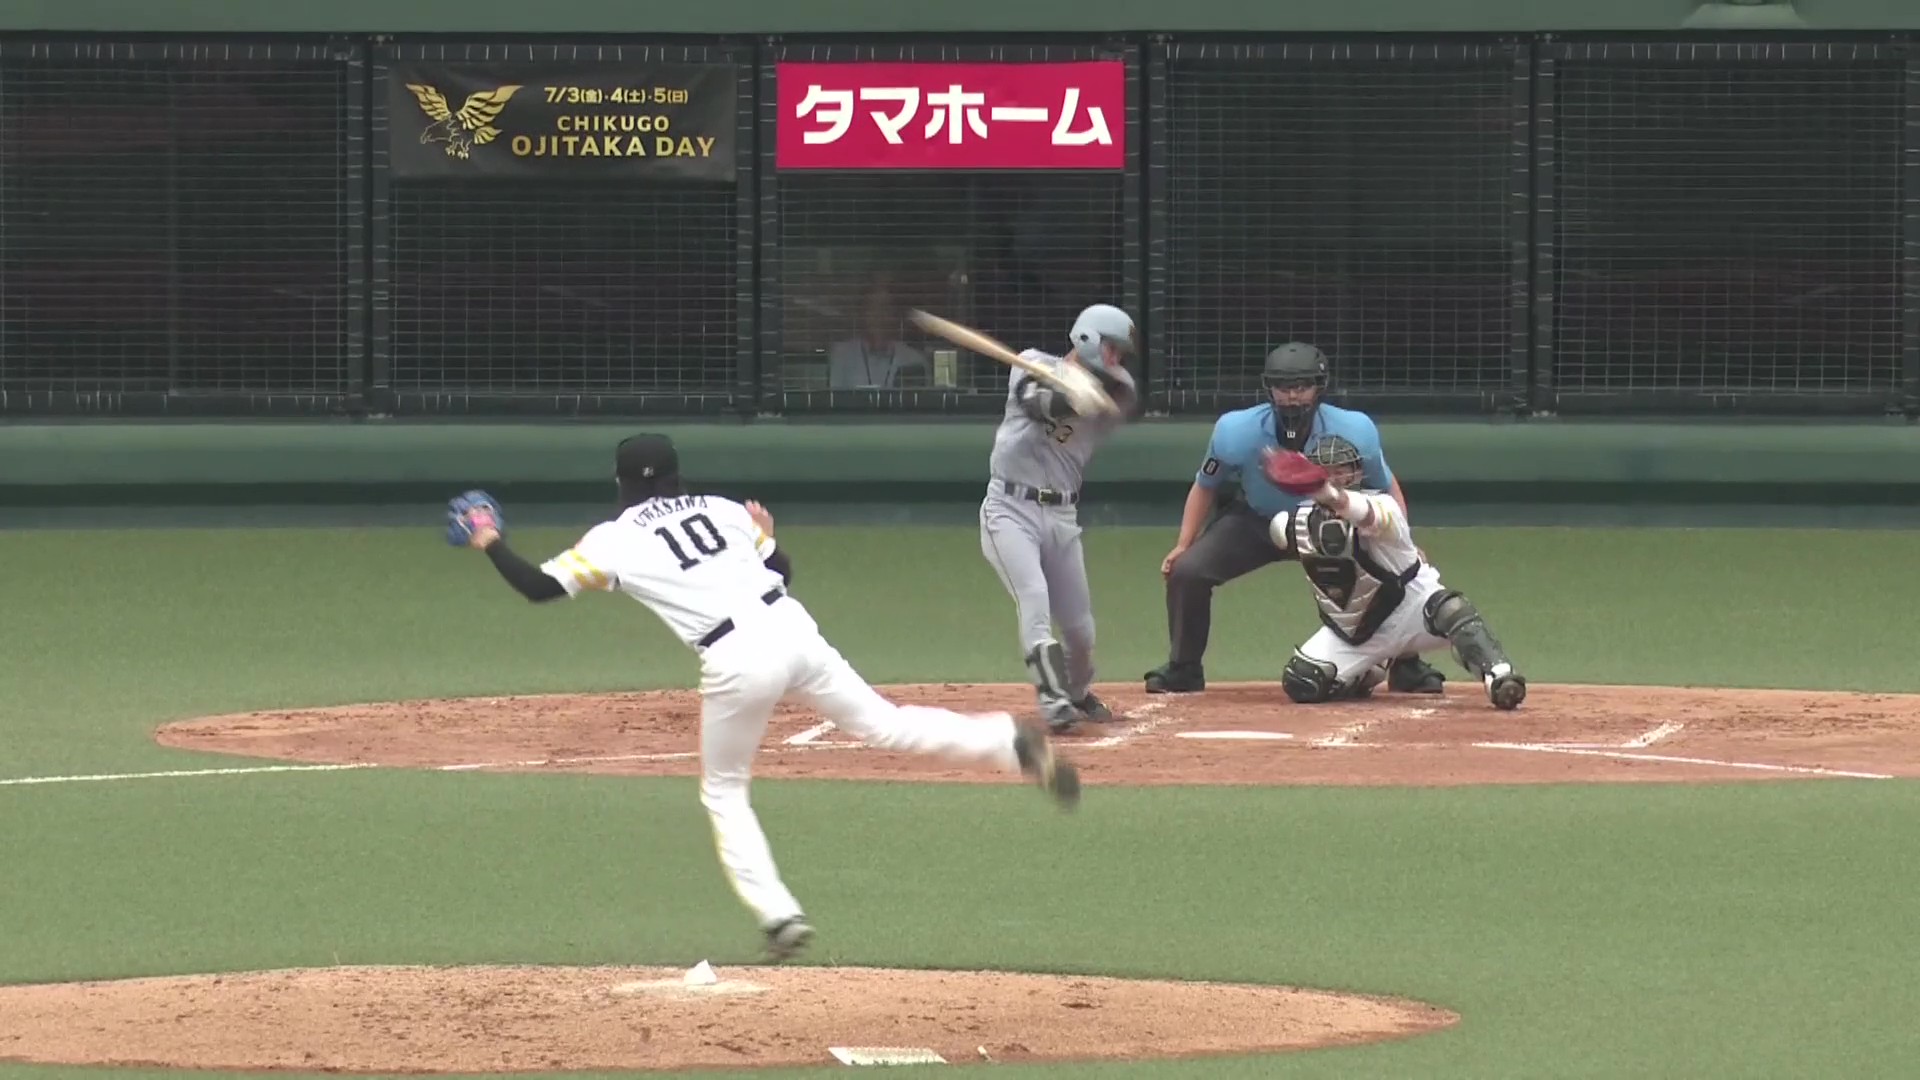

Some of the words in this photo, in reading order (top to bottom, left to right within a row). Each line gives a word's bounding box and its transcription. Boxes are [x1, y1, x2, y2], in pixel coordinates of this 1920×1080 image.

[557, 115, 670, 132] CHIKUGO
[796, 84, 1113, 145] タマホーム
[511, 136, 646, 157] OJITAKA
[656, 136, 716, 157] DAY
[654, 513, 727, 571] 10
